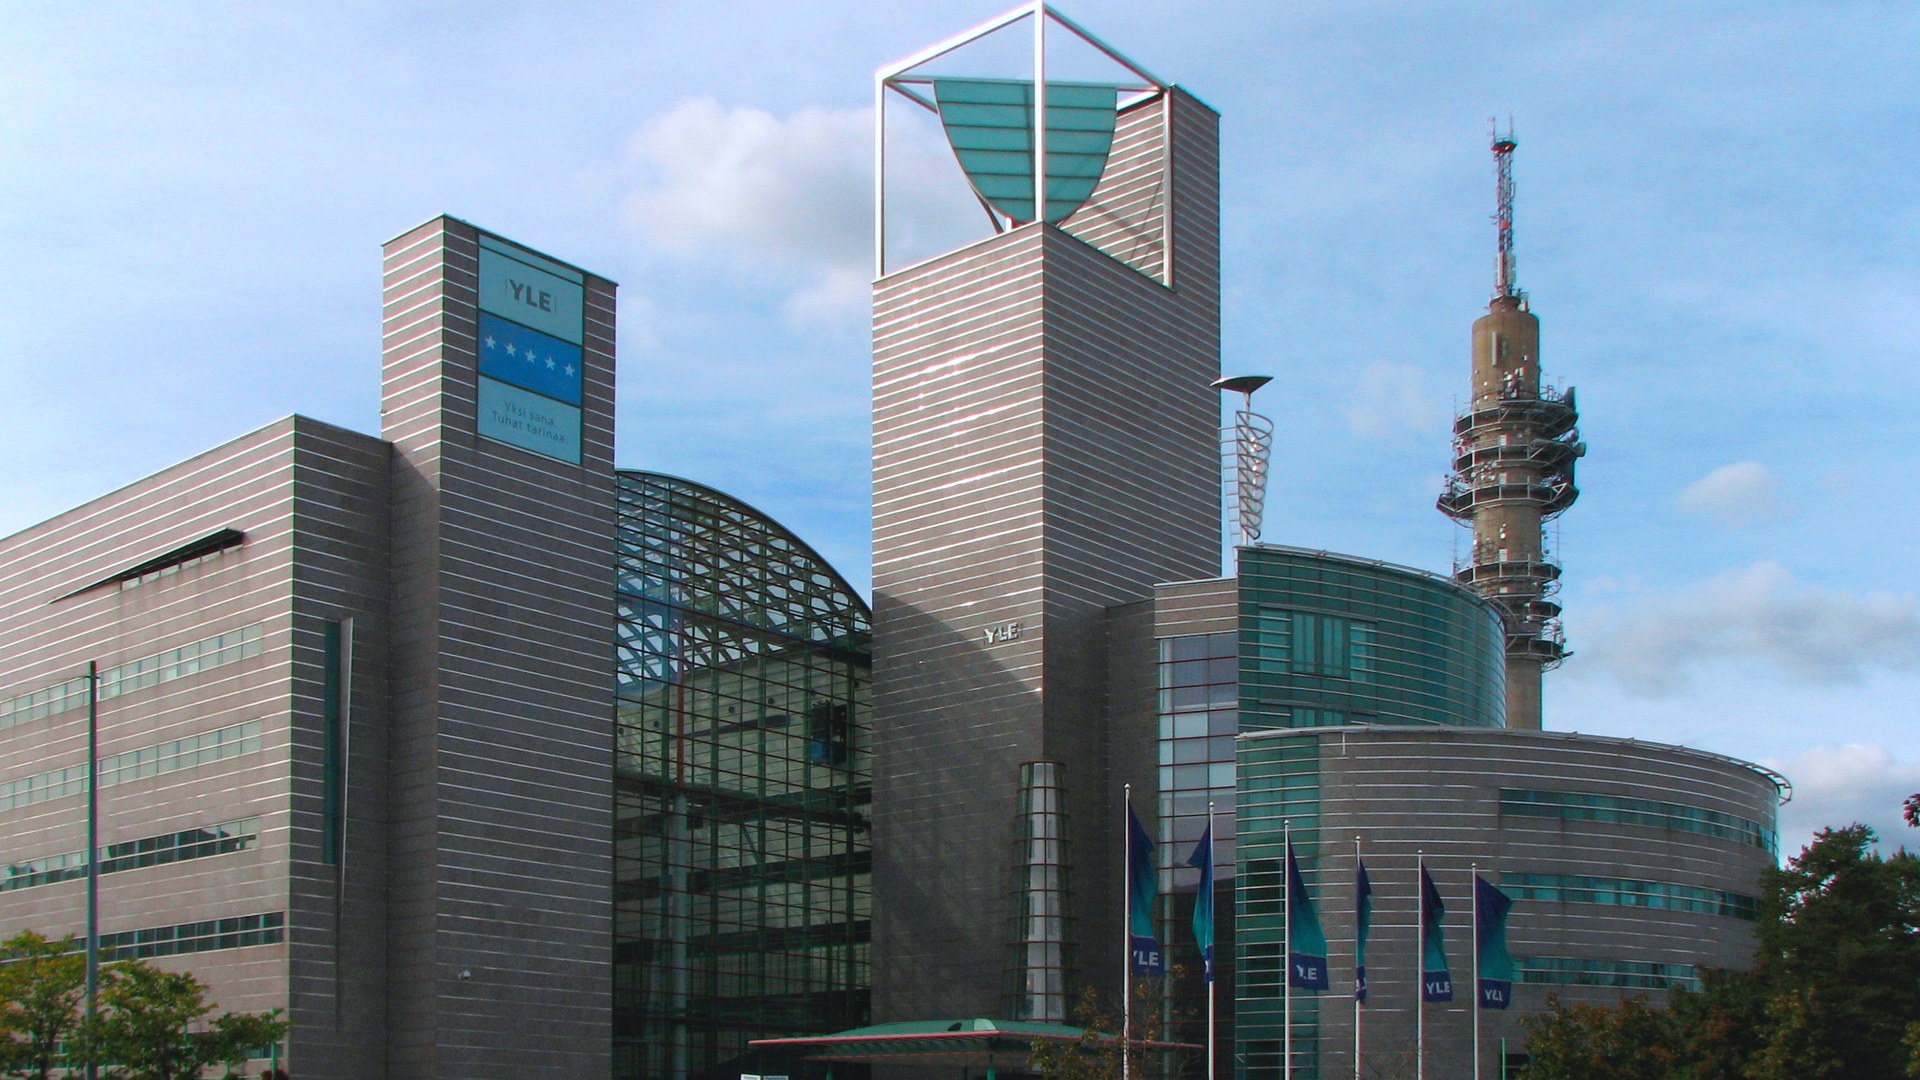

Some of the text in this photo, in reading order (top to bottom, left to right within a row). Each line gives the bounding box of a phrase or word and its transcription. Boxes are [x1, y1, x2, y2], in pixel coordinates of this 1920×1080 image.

[508, 278, 551, 313] YLE
[492, 410, 523, 430] Tuhat
[503, 400, 554, 427] Yksi sana
[983, 621, 1018, 645] YLE
[1295, 964, 1318, 980] YE
[1426, 981, 1451, 995] YLE
